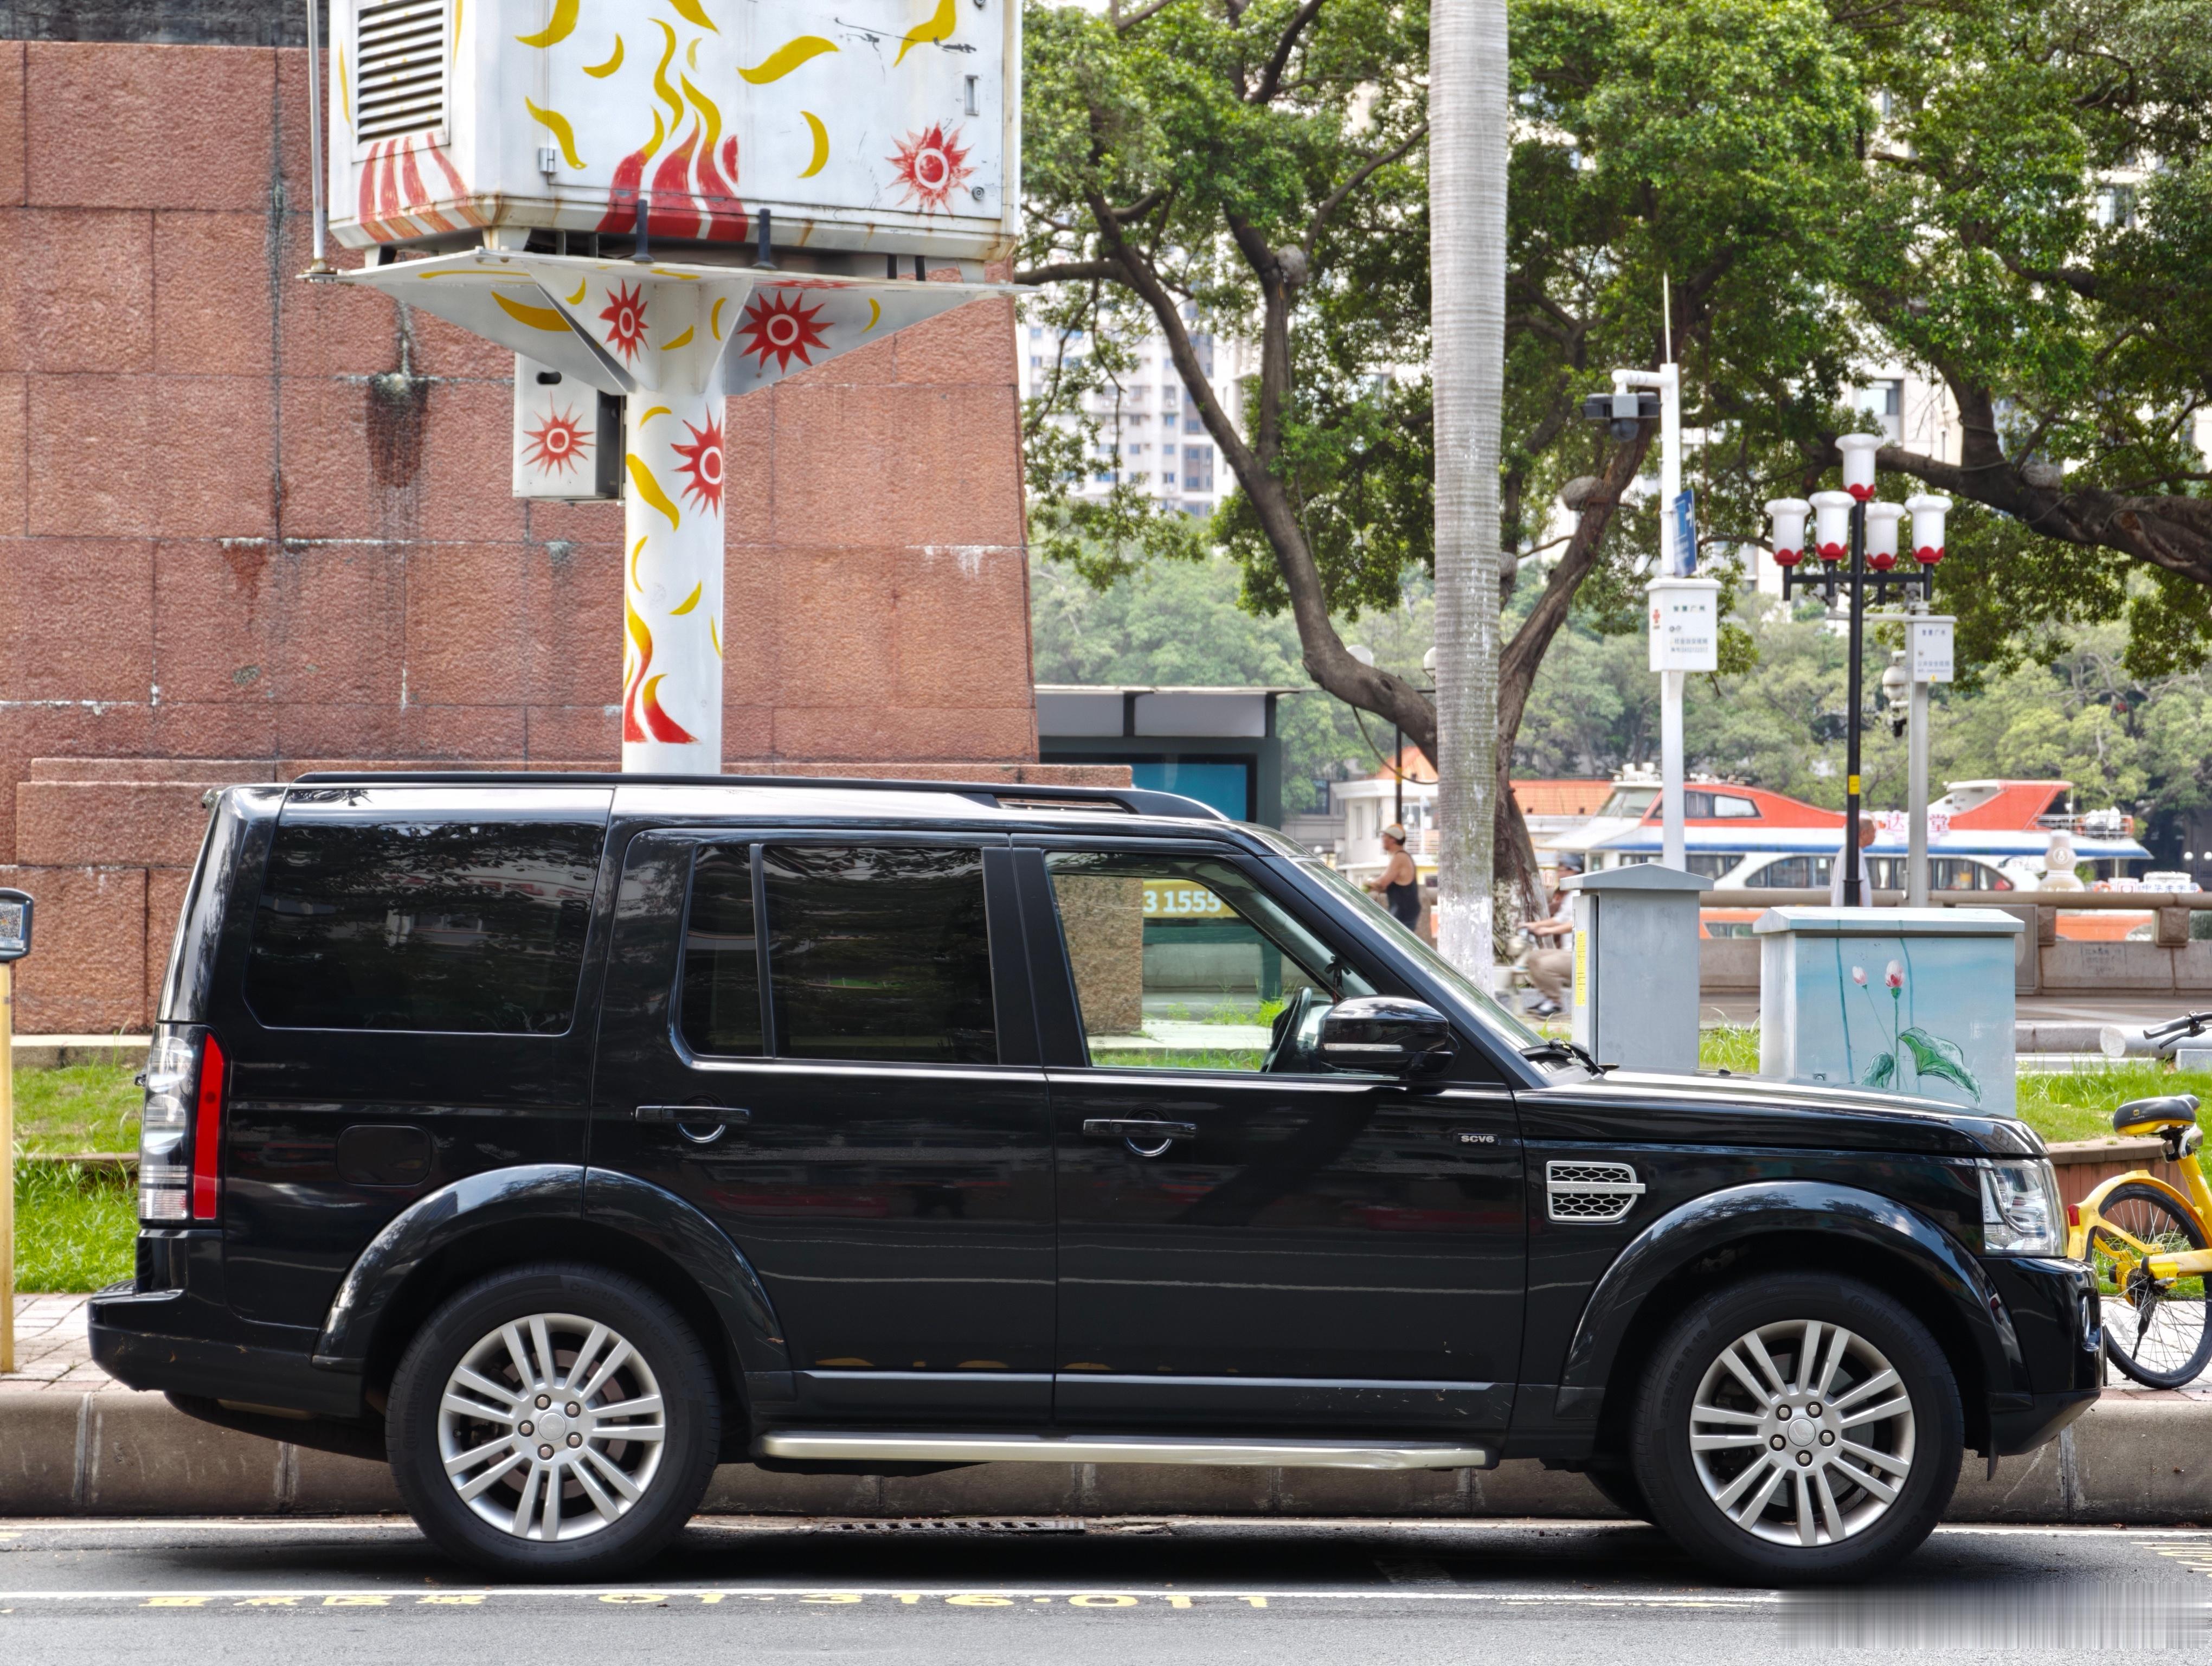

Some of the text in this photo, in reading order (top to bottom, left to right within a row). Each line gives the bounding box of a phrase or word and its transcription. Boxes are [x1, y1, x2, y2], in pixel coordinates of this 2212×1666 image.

[1163, 890, 1221, 913] 1555
[1461, 1135, 1495, 1143] SCV6
[1595, 1184, 1639, 1193] ROVER
